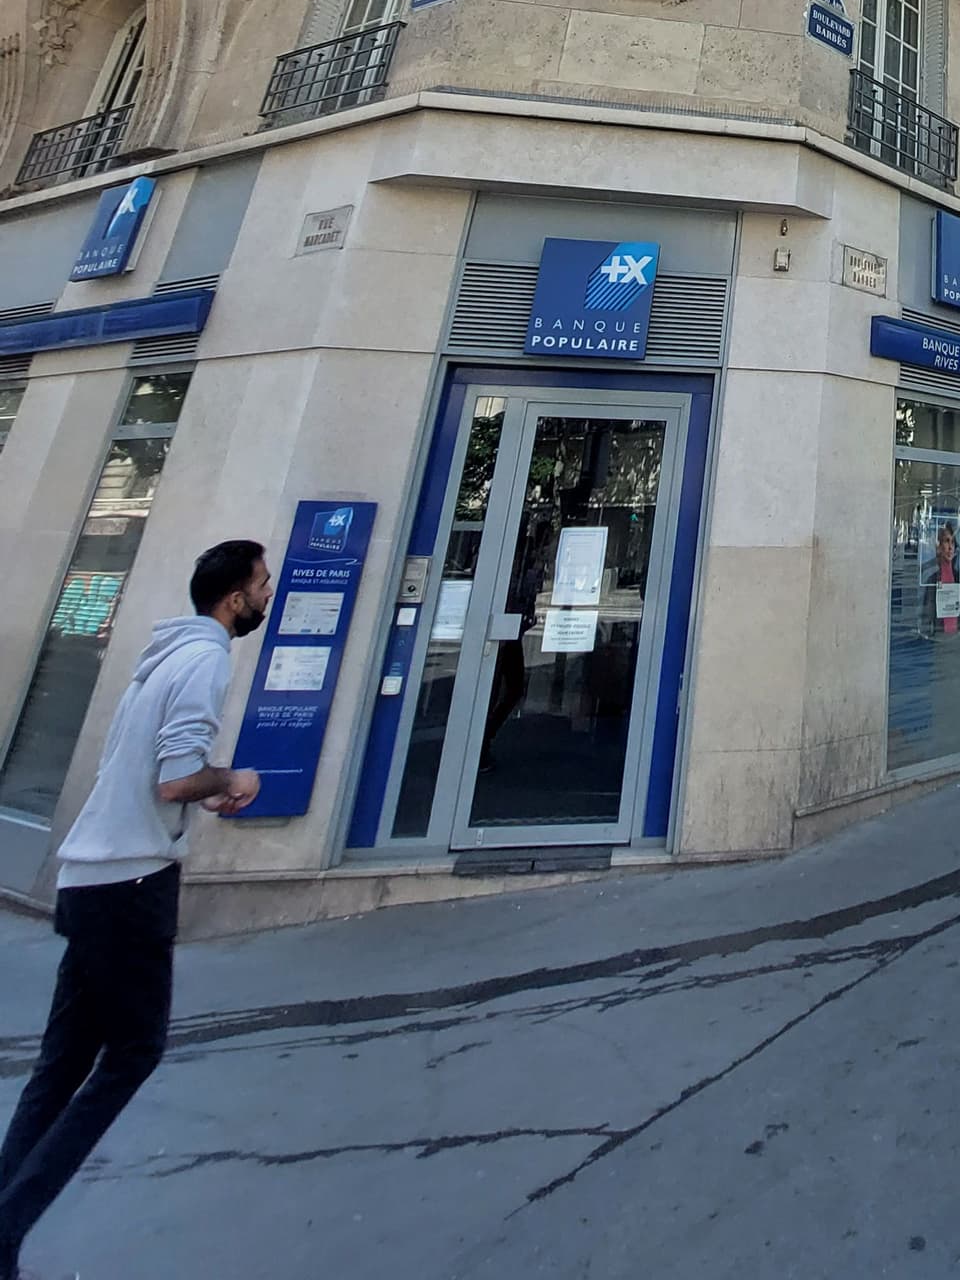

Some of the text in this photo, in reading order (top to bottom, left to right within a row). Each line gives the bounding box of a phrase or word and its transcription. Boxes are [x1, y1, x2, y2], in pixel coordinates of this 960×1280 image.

[812, 9, 851, 38] BOULEVARD
[72, 258, 118, 274] POPULAIRE
[534, 317, 641, 334] BANQUE
[531, 335, 639, 352] POPULAIRE
[922, 337, 960, 358] BANQUE
[934, 354, 957, 370] RIVES
[292, 568, 351, 578] RIVES DE PARIS
